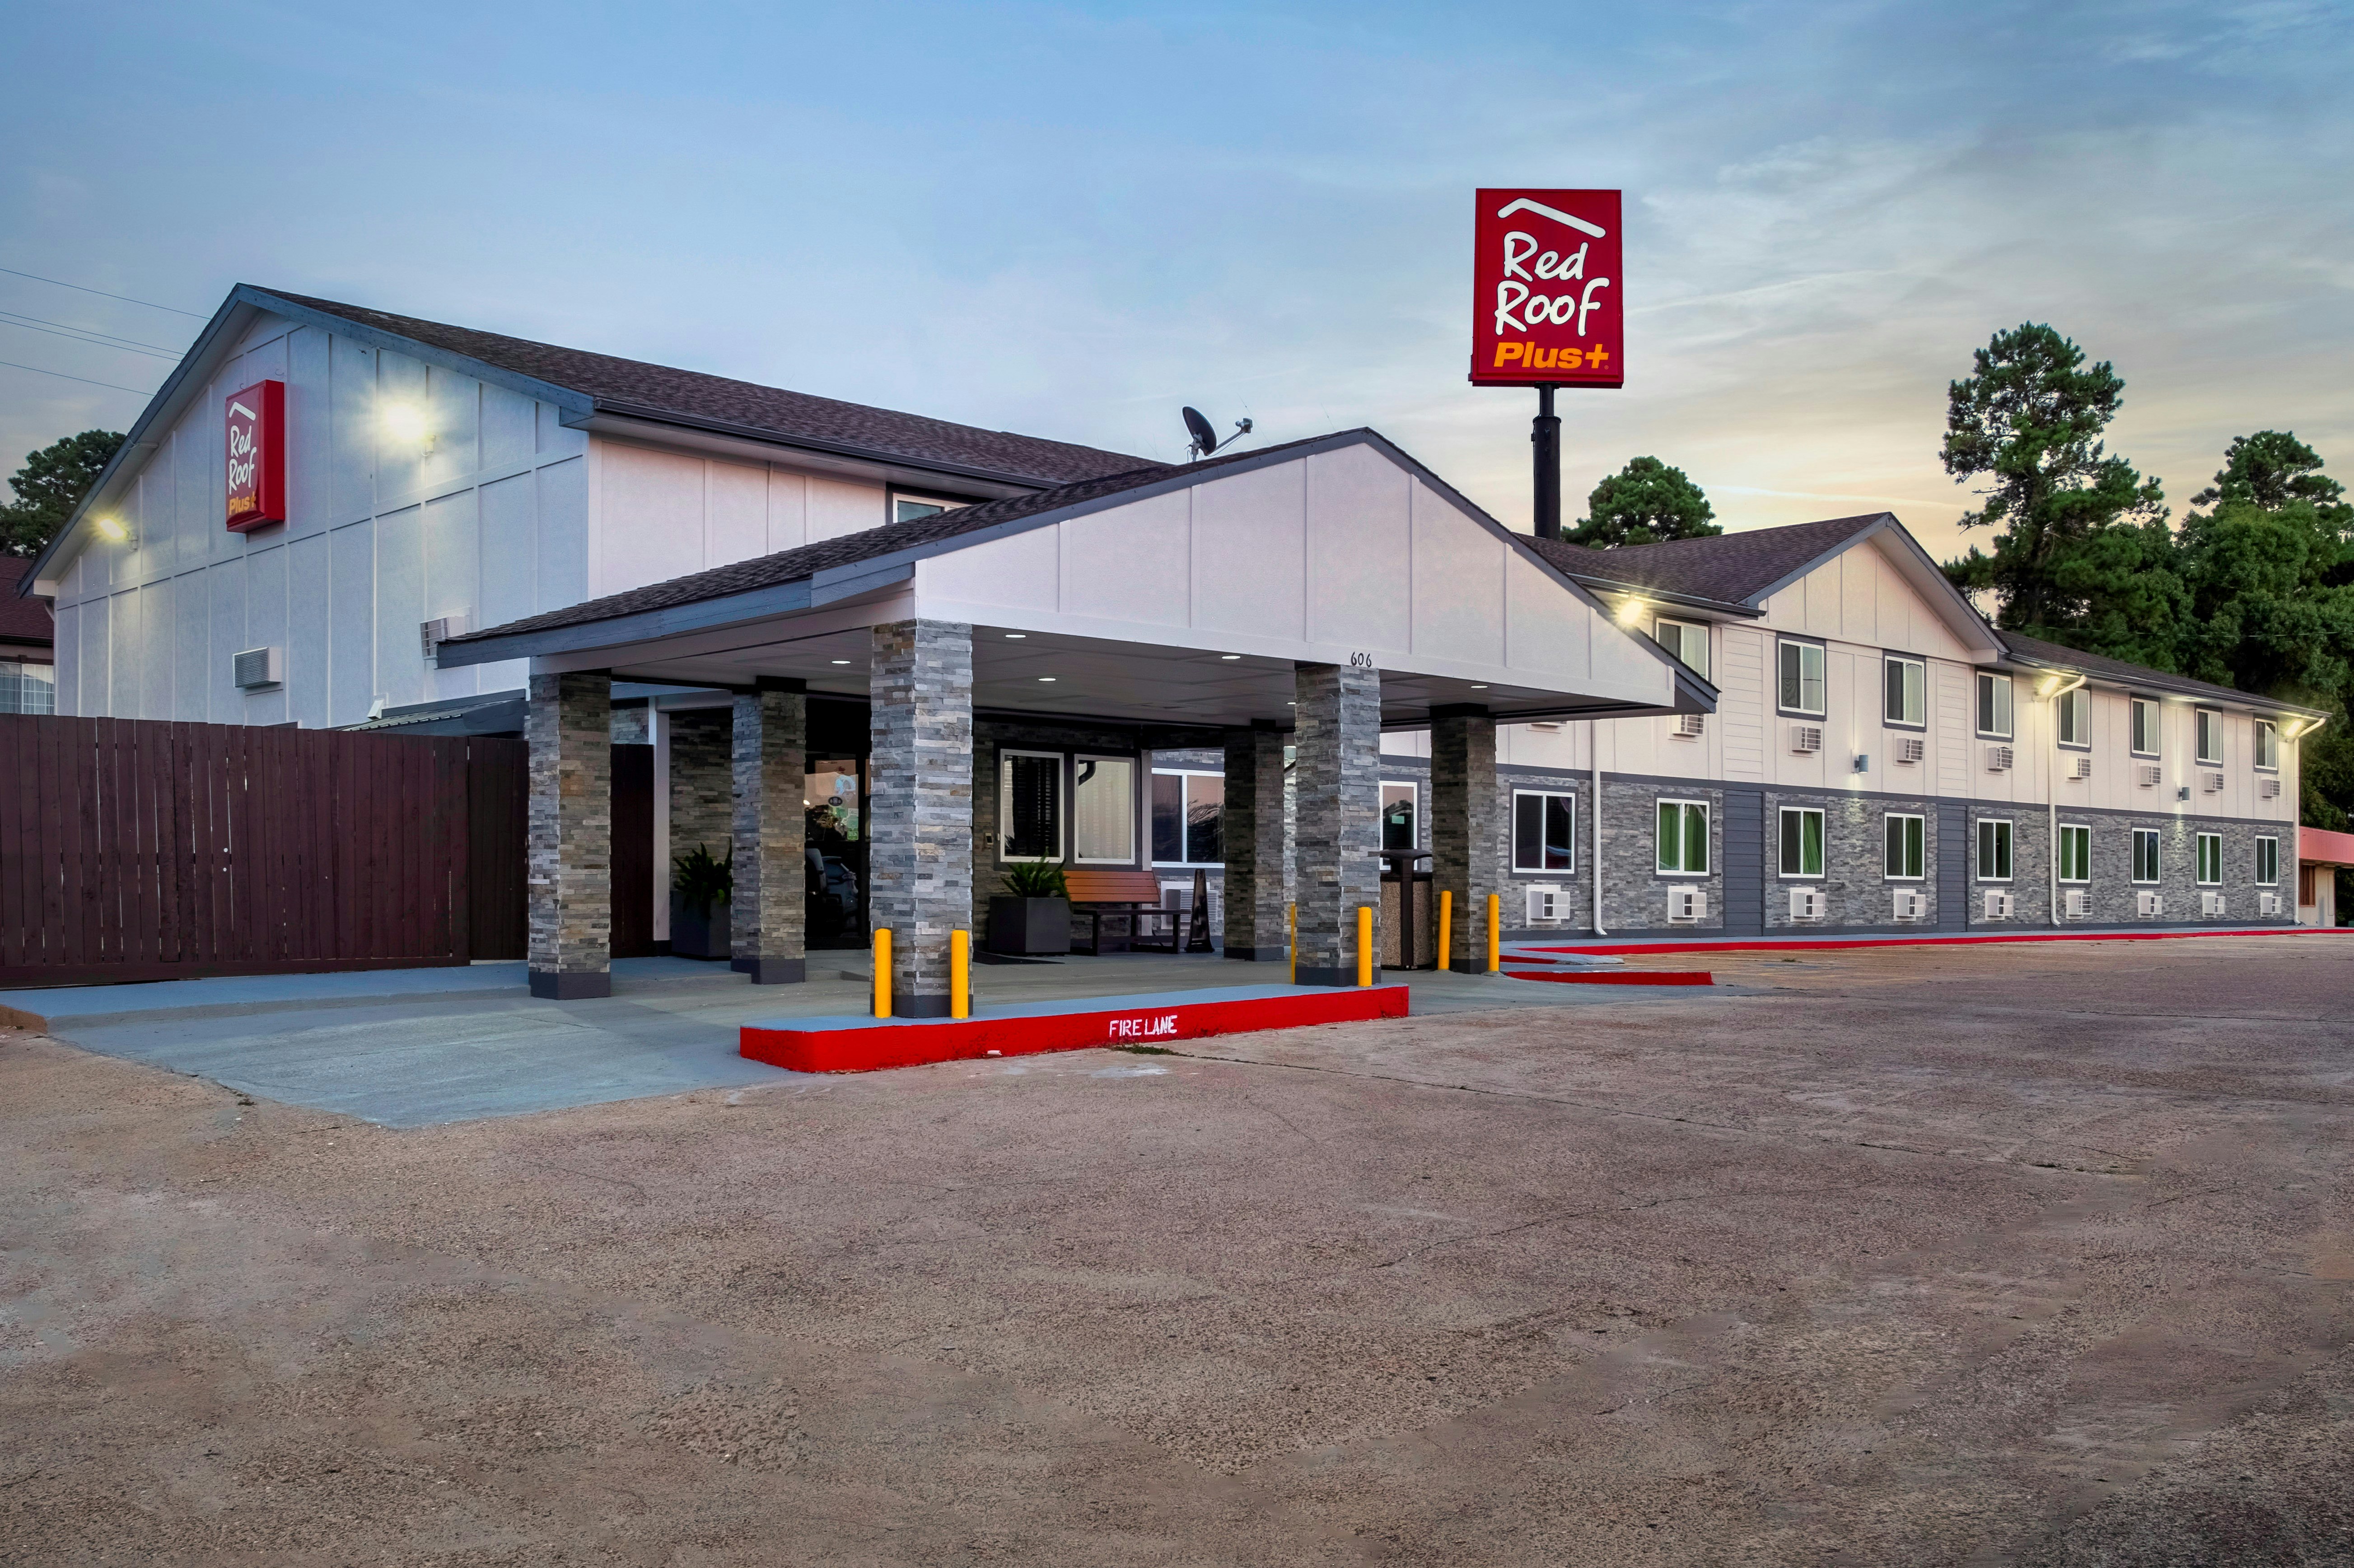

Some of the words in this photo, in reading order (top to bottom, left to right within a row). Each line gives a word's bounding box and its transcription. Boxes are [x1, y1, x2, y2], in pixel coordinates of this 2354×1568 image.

[1504, 231, 1588, 282] Red
[1494, 277, 1610, 337] Roof
[1493, 341, 1609, 369] Plus+
[230, 425, 252, 458] Red
[229, 446, 257, 495] Roof
[229, 491, 257, 516] Plus+
[1350, 651, 1372, 667] 606
[1109, 1019, 1143, 1037] FIRE
[1144, 1015, 1178, 1035] LANE
